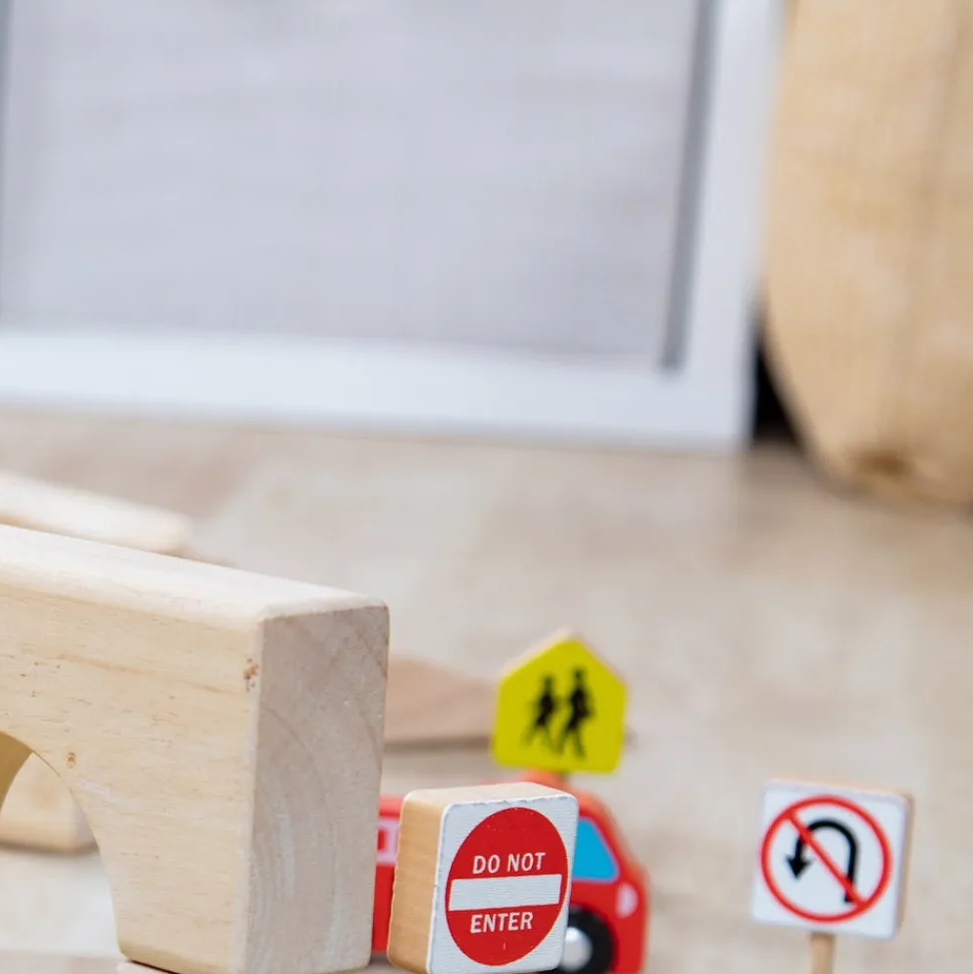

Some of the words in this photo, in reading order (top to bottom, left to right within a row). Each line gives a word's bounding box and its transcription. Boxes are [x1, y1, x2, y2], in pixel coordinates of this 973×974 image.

[472, 854, 500, 874] DO
[507, 852, 546, 872] NOT
[470, 911, 533, 934] ENTER
